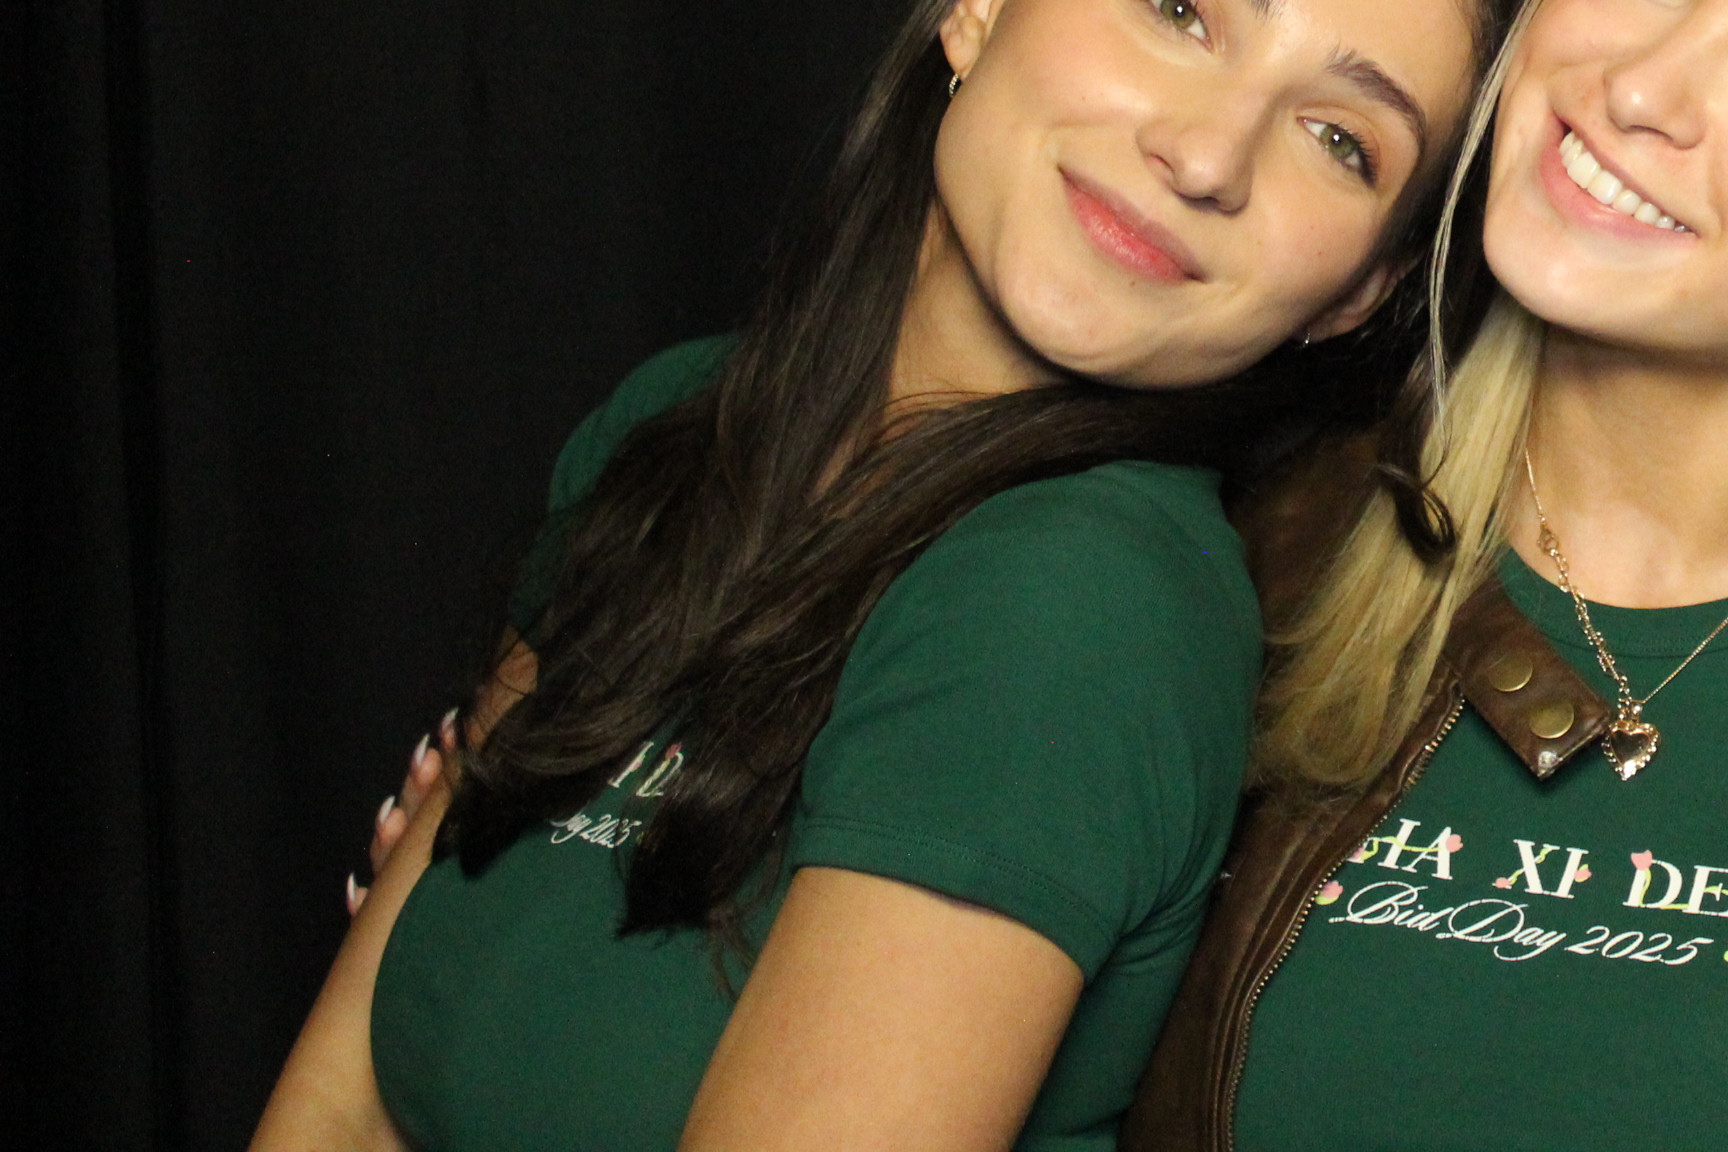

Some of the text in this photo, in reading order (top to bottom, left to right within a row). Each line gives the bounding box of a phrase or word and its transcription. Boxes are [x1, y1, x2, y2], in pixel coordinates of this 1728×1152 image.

[1491, 838, 1590, 899] XI
[1328, 880, 1714, 966] Bid Day 2025
